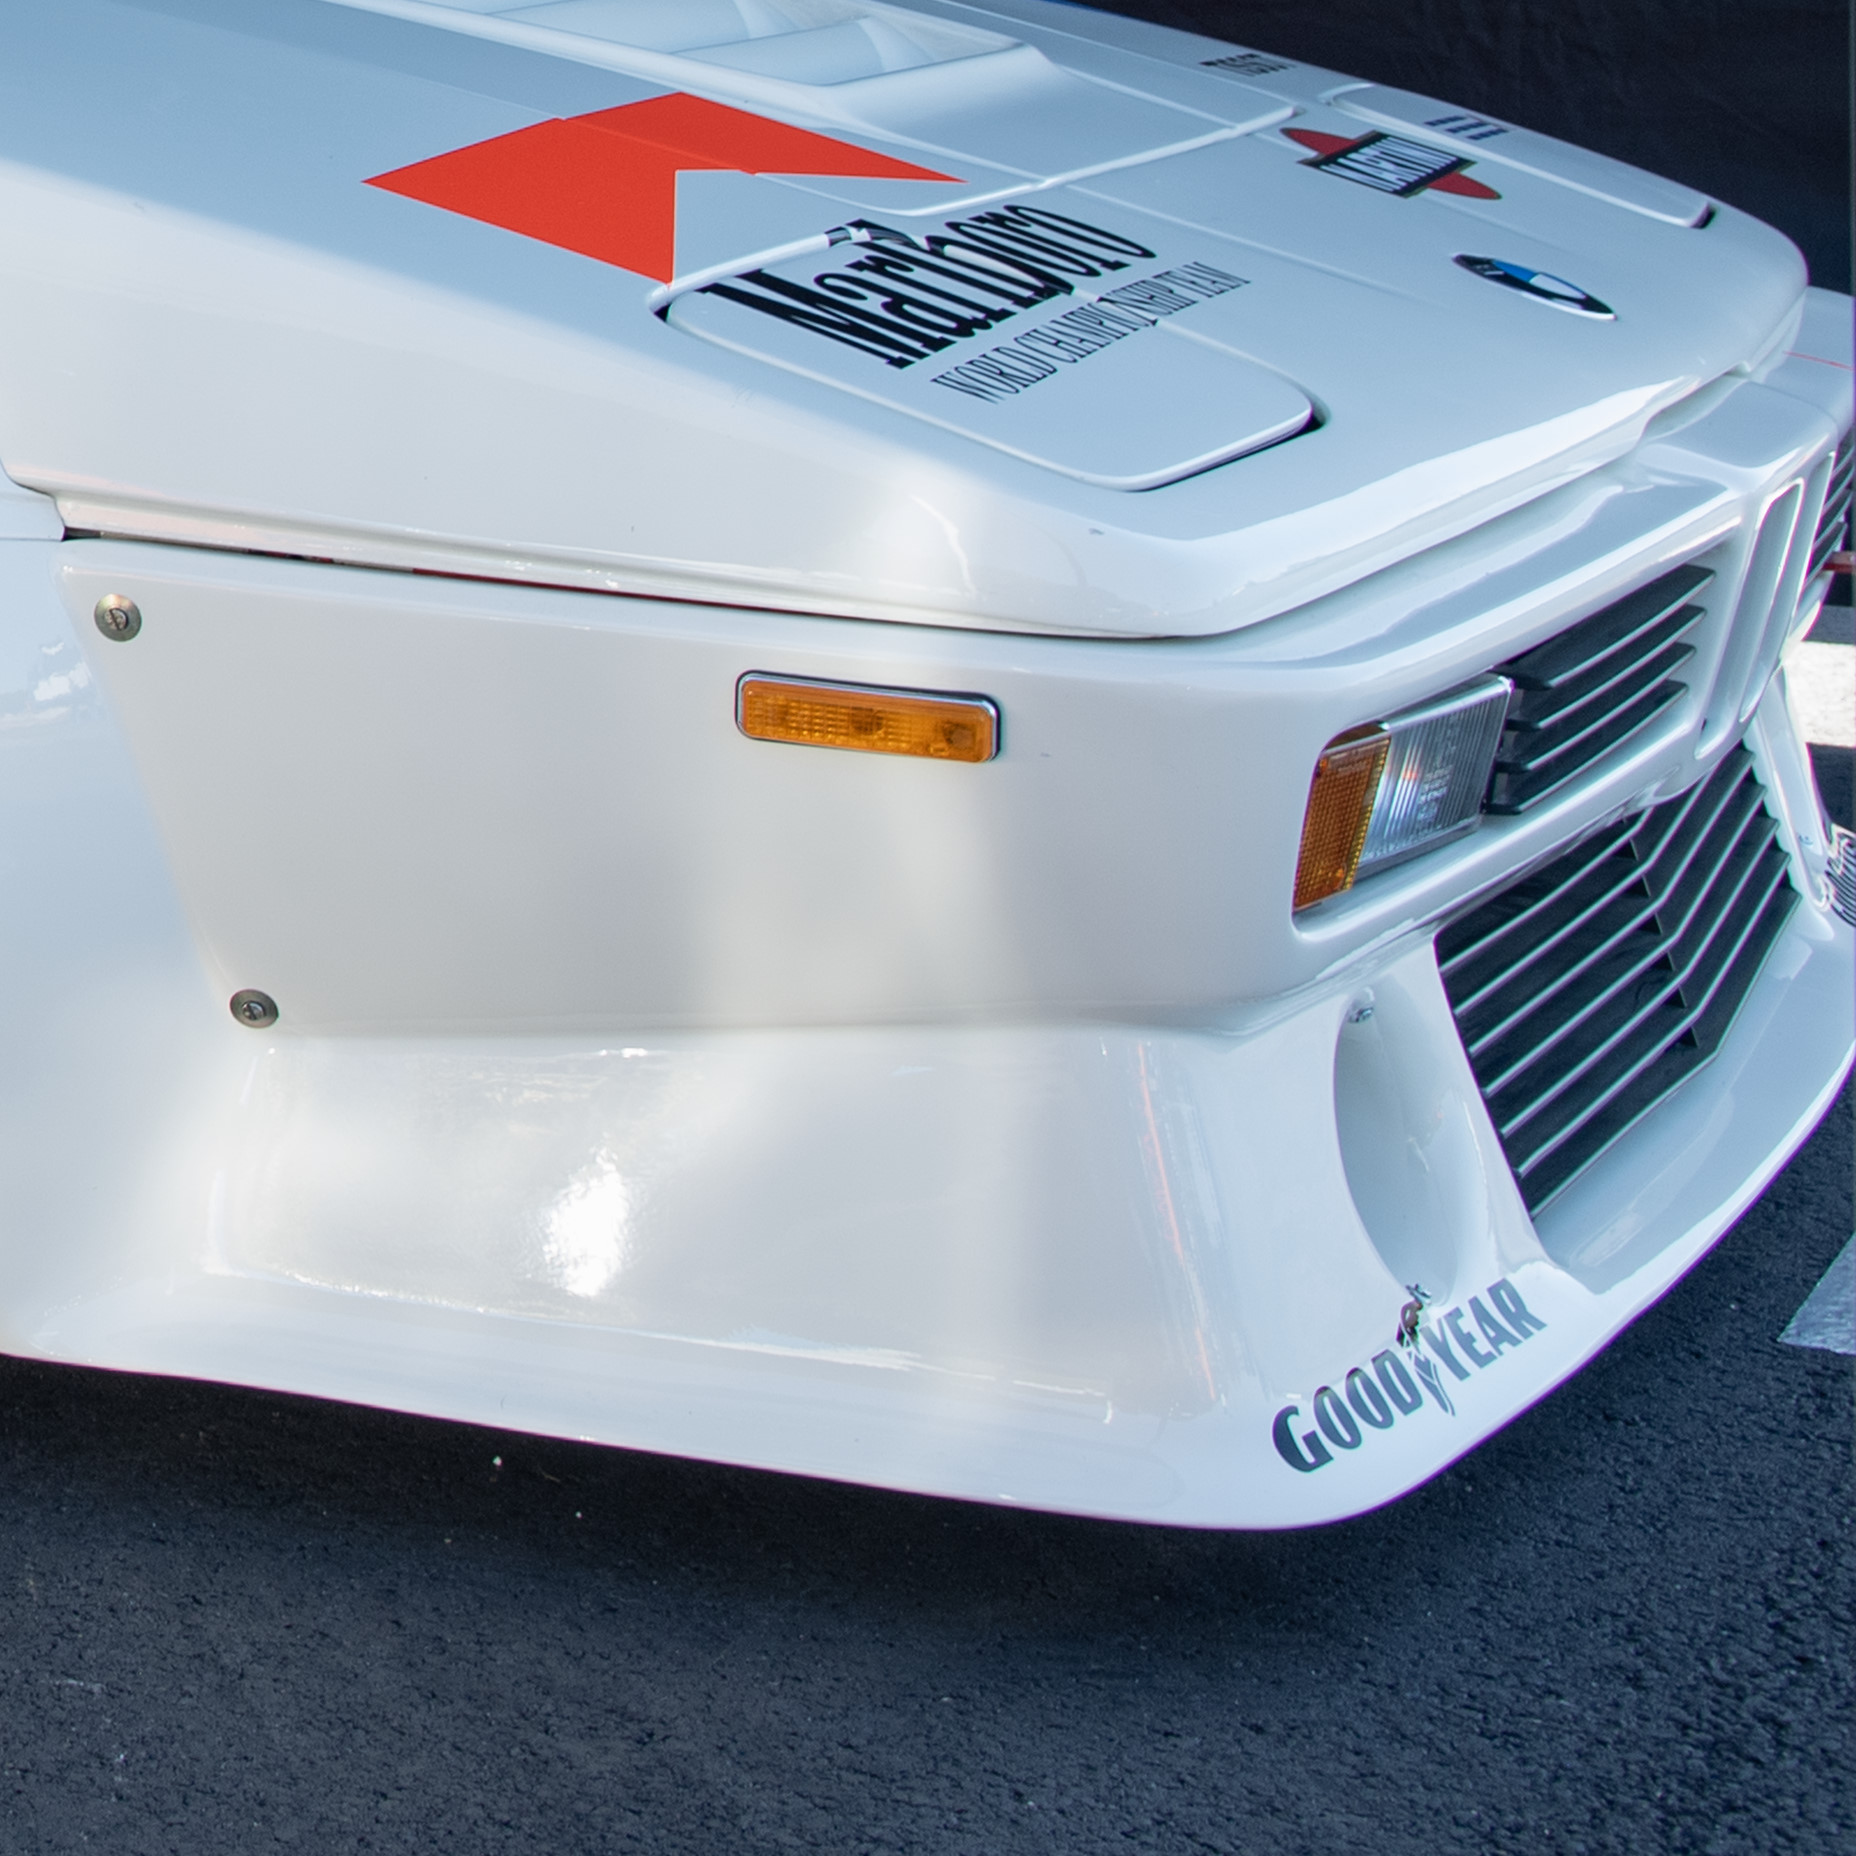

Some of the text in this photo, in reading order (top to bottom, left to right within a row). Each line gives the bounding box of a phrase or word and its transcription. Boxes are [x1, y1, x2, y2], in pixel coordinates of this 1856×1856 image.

[693, 205, 1157, 370] Marlboro
[930, 261, 1251, 405] WORLD CHAMPIONSHIP TEAM
[1272, 1278, 1548, 1473] GOODYEAR
